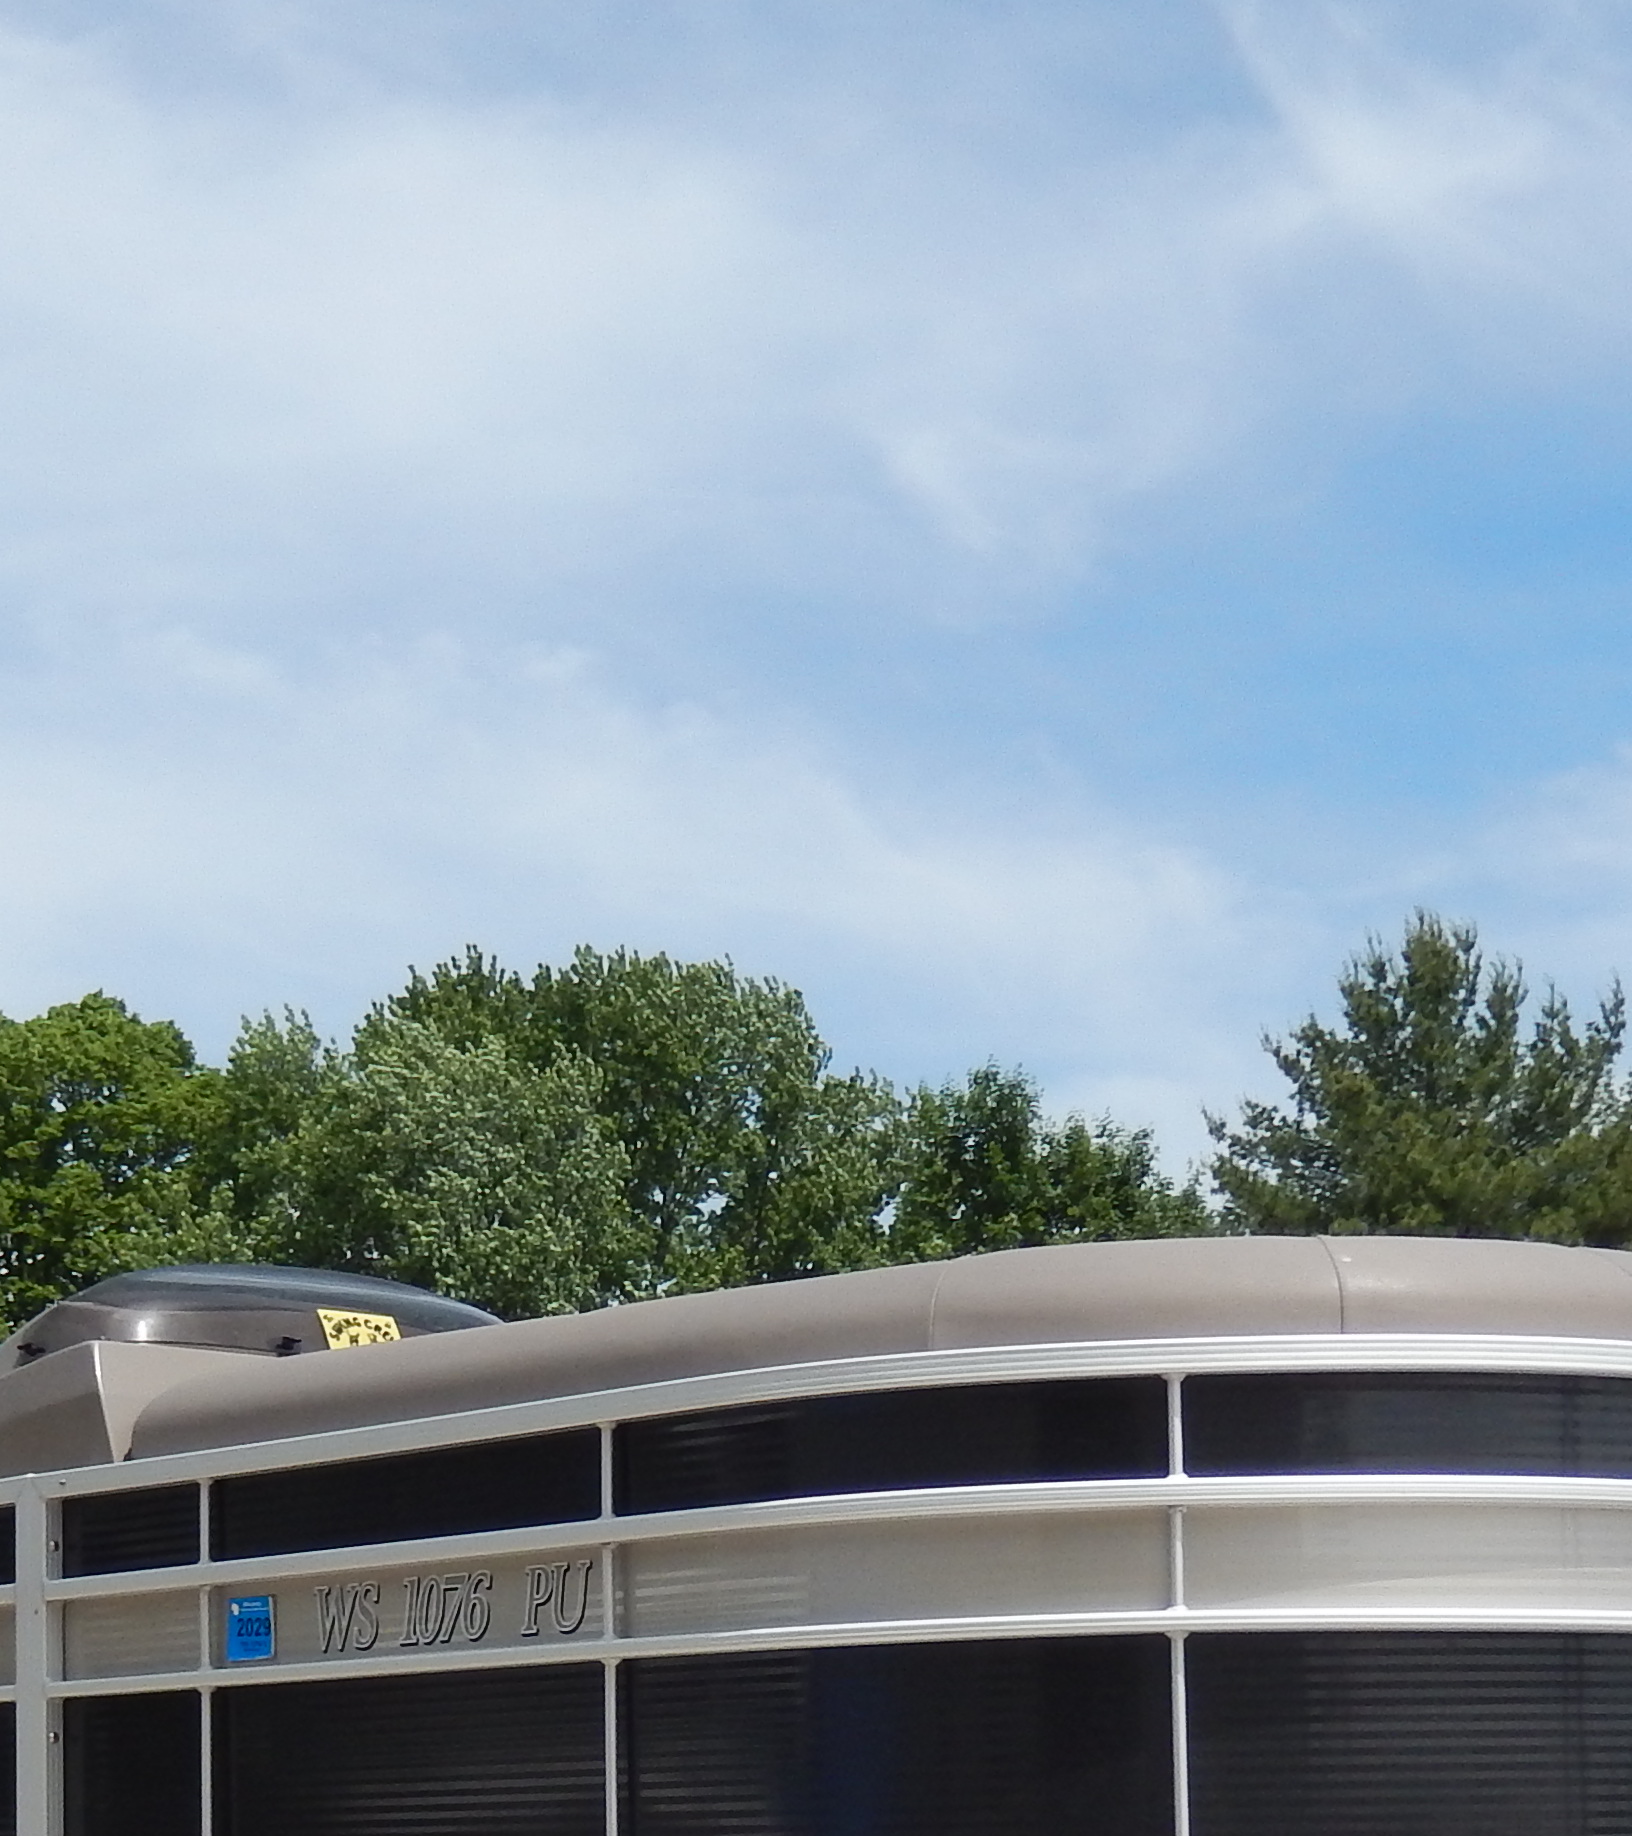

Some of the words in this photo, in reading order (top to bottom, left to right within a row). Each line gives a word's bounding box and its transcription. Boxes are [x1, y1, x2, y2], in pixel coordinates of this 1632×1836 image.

[314, 1581, 380, 1652] WS
[400, 1570, 492, 1646] 1076
[521, 1560, 593, 1638] PU
